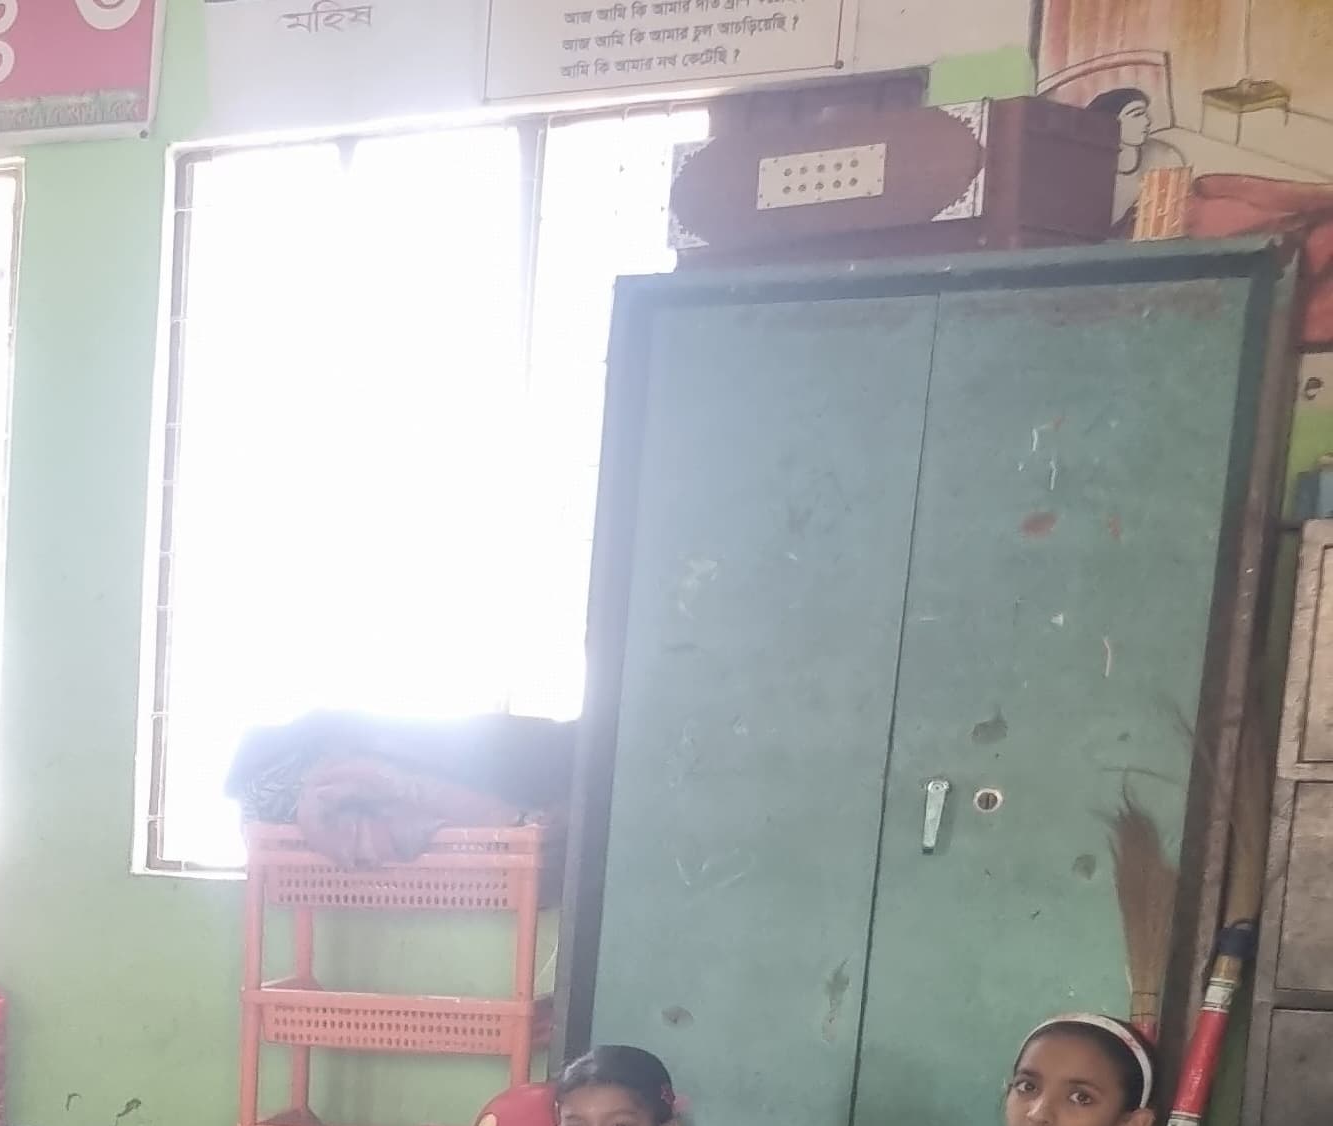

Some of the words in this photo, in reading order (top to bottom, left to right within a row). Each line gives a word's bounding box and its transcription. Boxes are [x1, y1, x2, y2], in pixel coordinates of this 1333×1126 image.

[282, 0, 373, 33] মহিষ
[597, 5, 626, 22] আমি
[631, 2, 647, 19] কি
[595, 32, 624, 49] আমি
[629, 30, 645, 49] কি
[649, 25, 688, 42] আমার
[560, 60, 589, 79] আমি
[594, 59, 609, 76] কি
[614, 57, 652, 74] আমার
